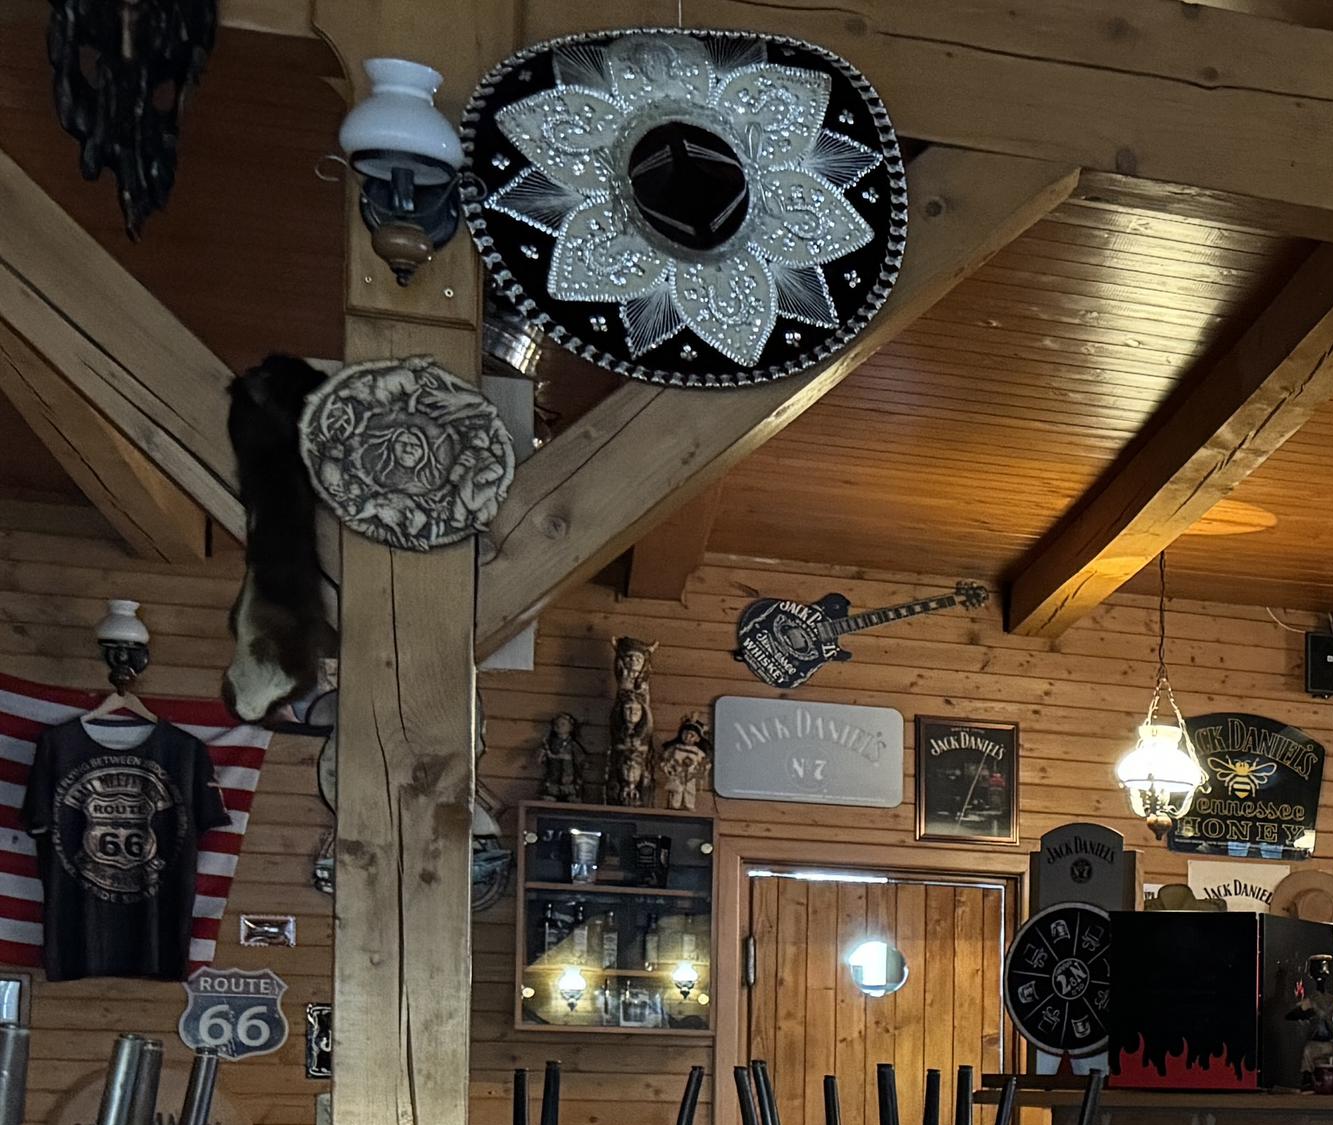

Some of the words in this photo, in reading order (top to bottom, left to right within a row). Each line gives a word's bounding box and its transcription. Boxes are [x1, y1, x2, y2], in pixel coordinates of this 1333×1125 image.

[743, 637, 785, 684] WHISKEY
[733, 715, 791, 752] JACK
[796, 708, 887, 764] DANIEL'S
[929, 735, 960, 757] JACK
[960, 731, 1007, 761] DANIEL'S
[1193, 725, 1228, 755] CK
[1227, 717, 1319, 780] DANIEL'S
[93, 804, 148, 815] ROUTE
[100, 832, 145, 858] 66
[1174, 815, 1307, 845] HONEY
[1046, 843, 1075, 866] JACK
[1203, 881, 1233, 901] JACK
[1233, 879, 1274, 906] DANIEL
[200, 977, 272, 994] ROUTE
[199, 1004, 271, 1048] 66
